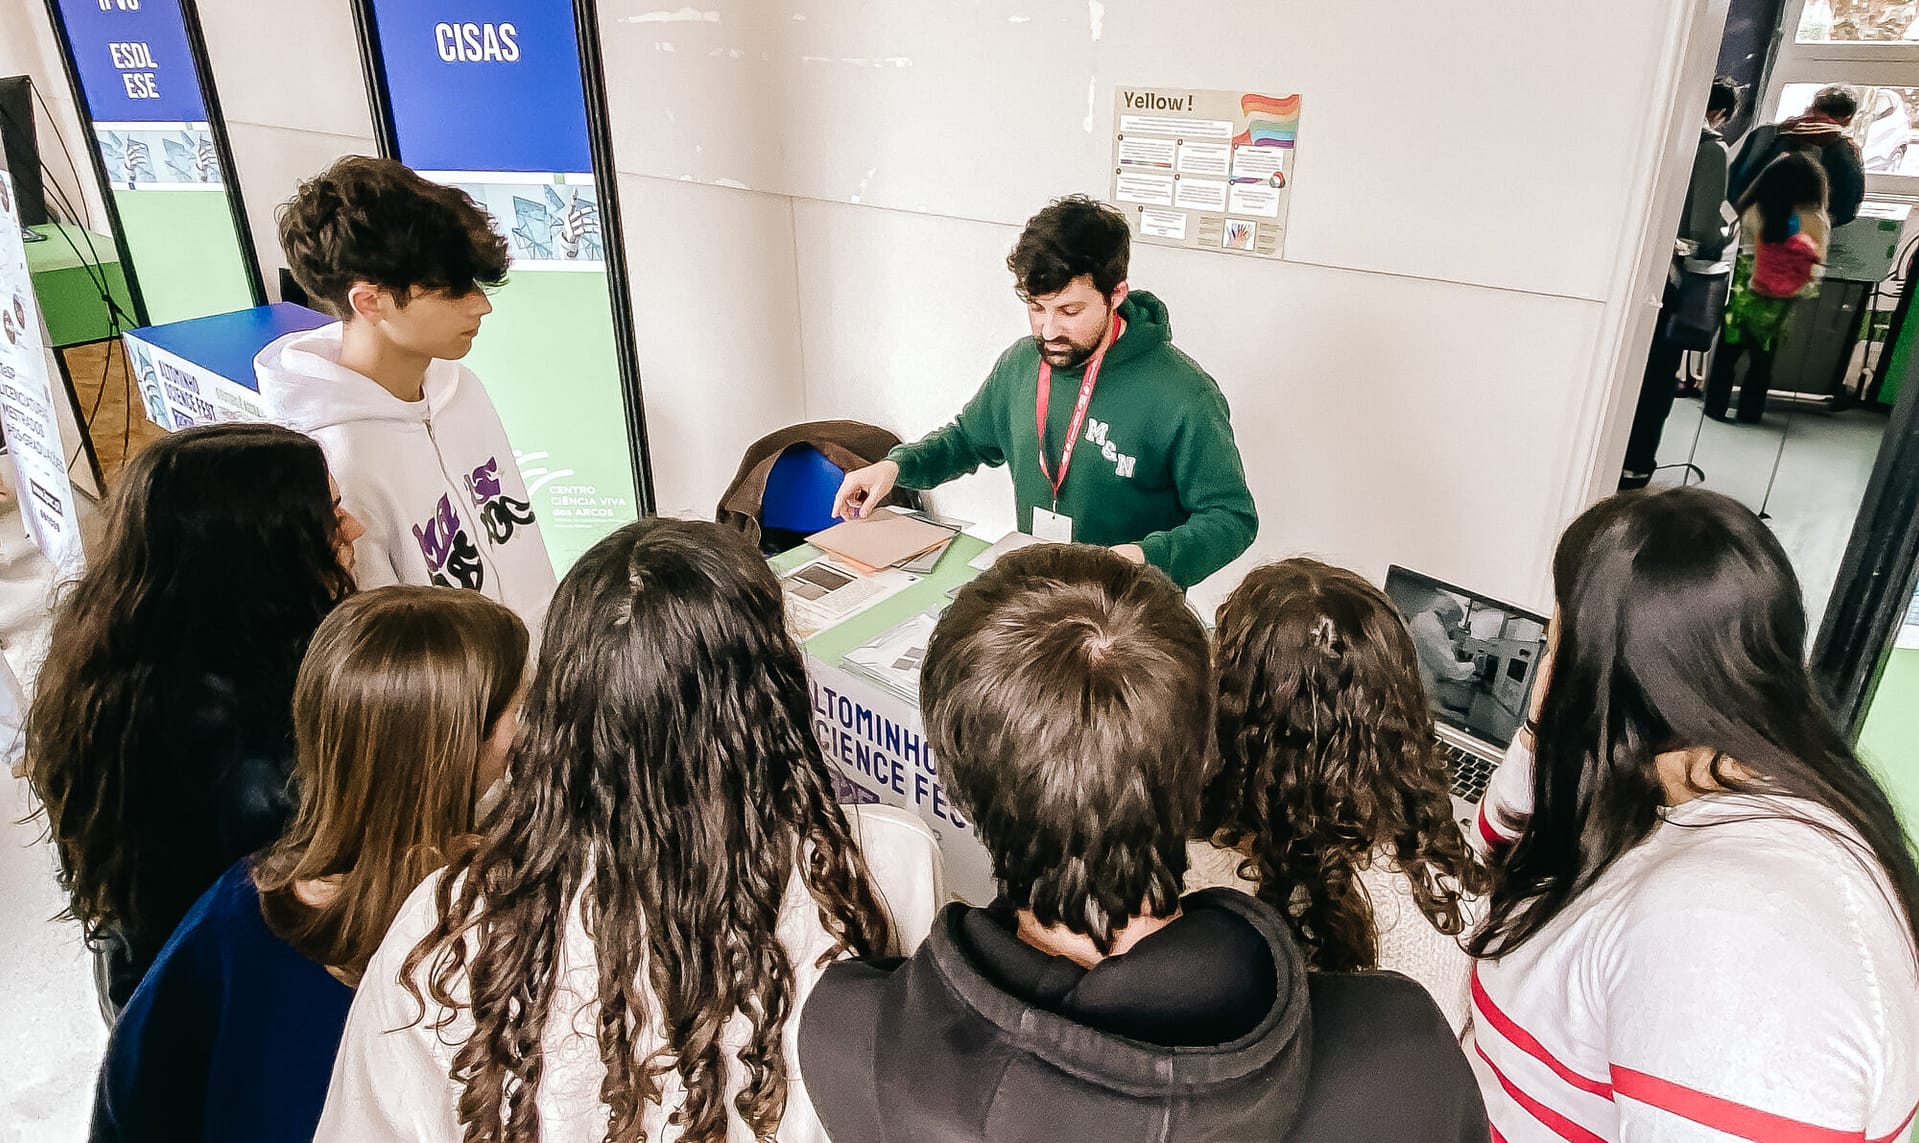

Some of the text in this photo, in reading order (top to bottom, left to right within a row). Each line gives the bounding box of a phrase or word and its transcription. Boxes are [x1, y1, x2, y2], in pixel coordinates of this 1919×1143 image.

[435, 23, 520, 62] CISAS
[109, 42, 159, 69] ESDL
[122, 73, 161, 99] ESE
[549, 486, 596, 494] CENTRO
[551, 496, 626, 506] CIÊNCIA VIVA
[575, 508, 614, 517] ARCOS
